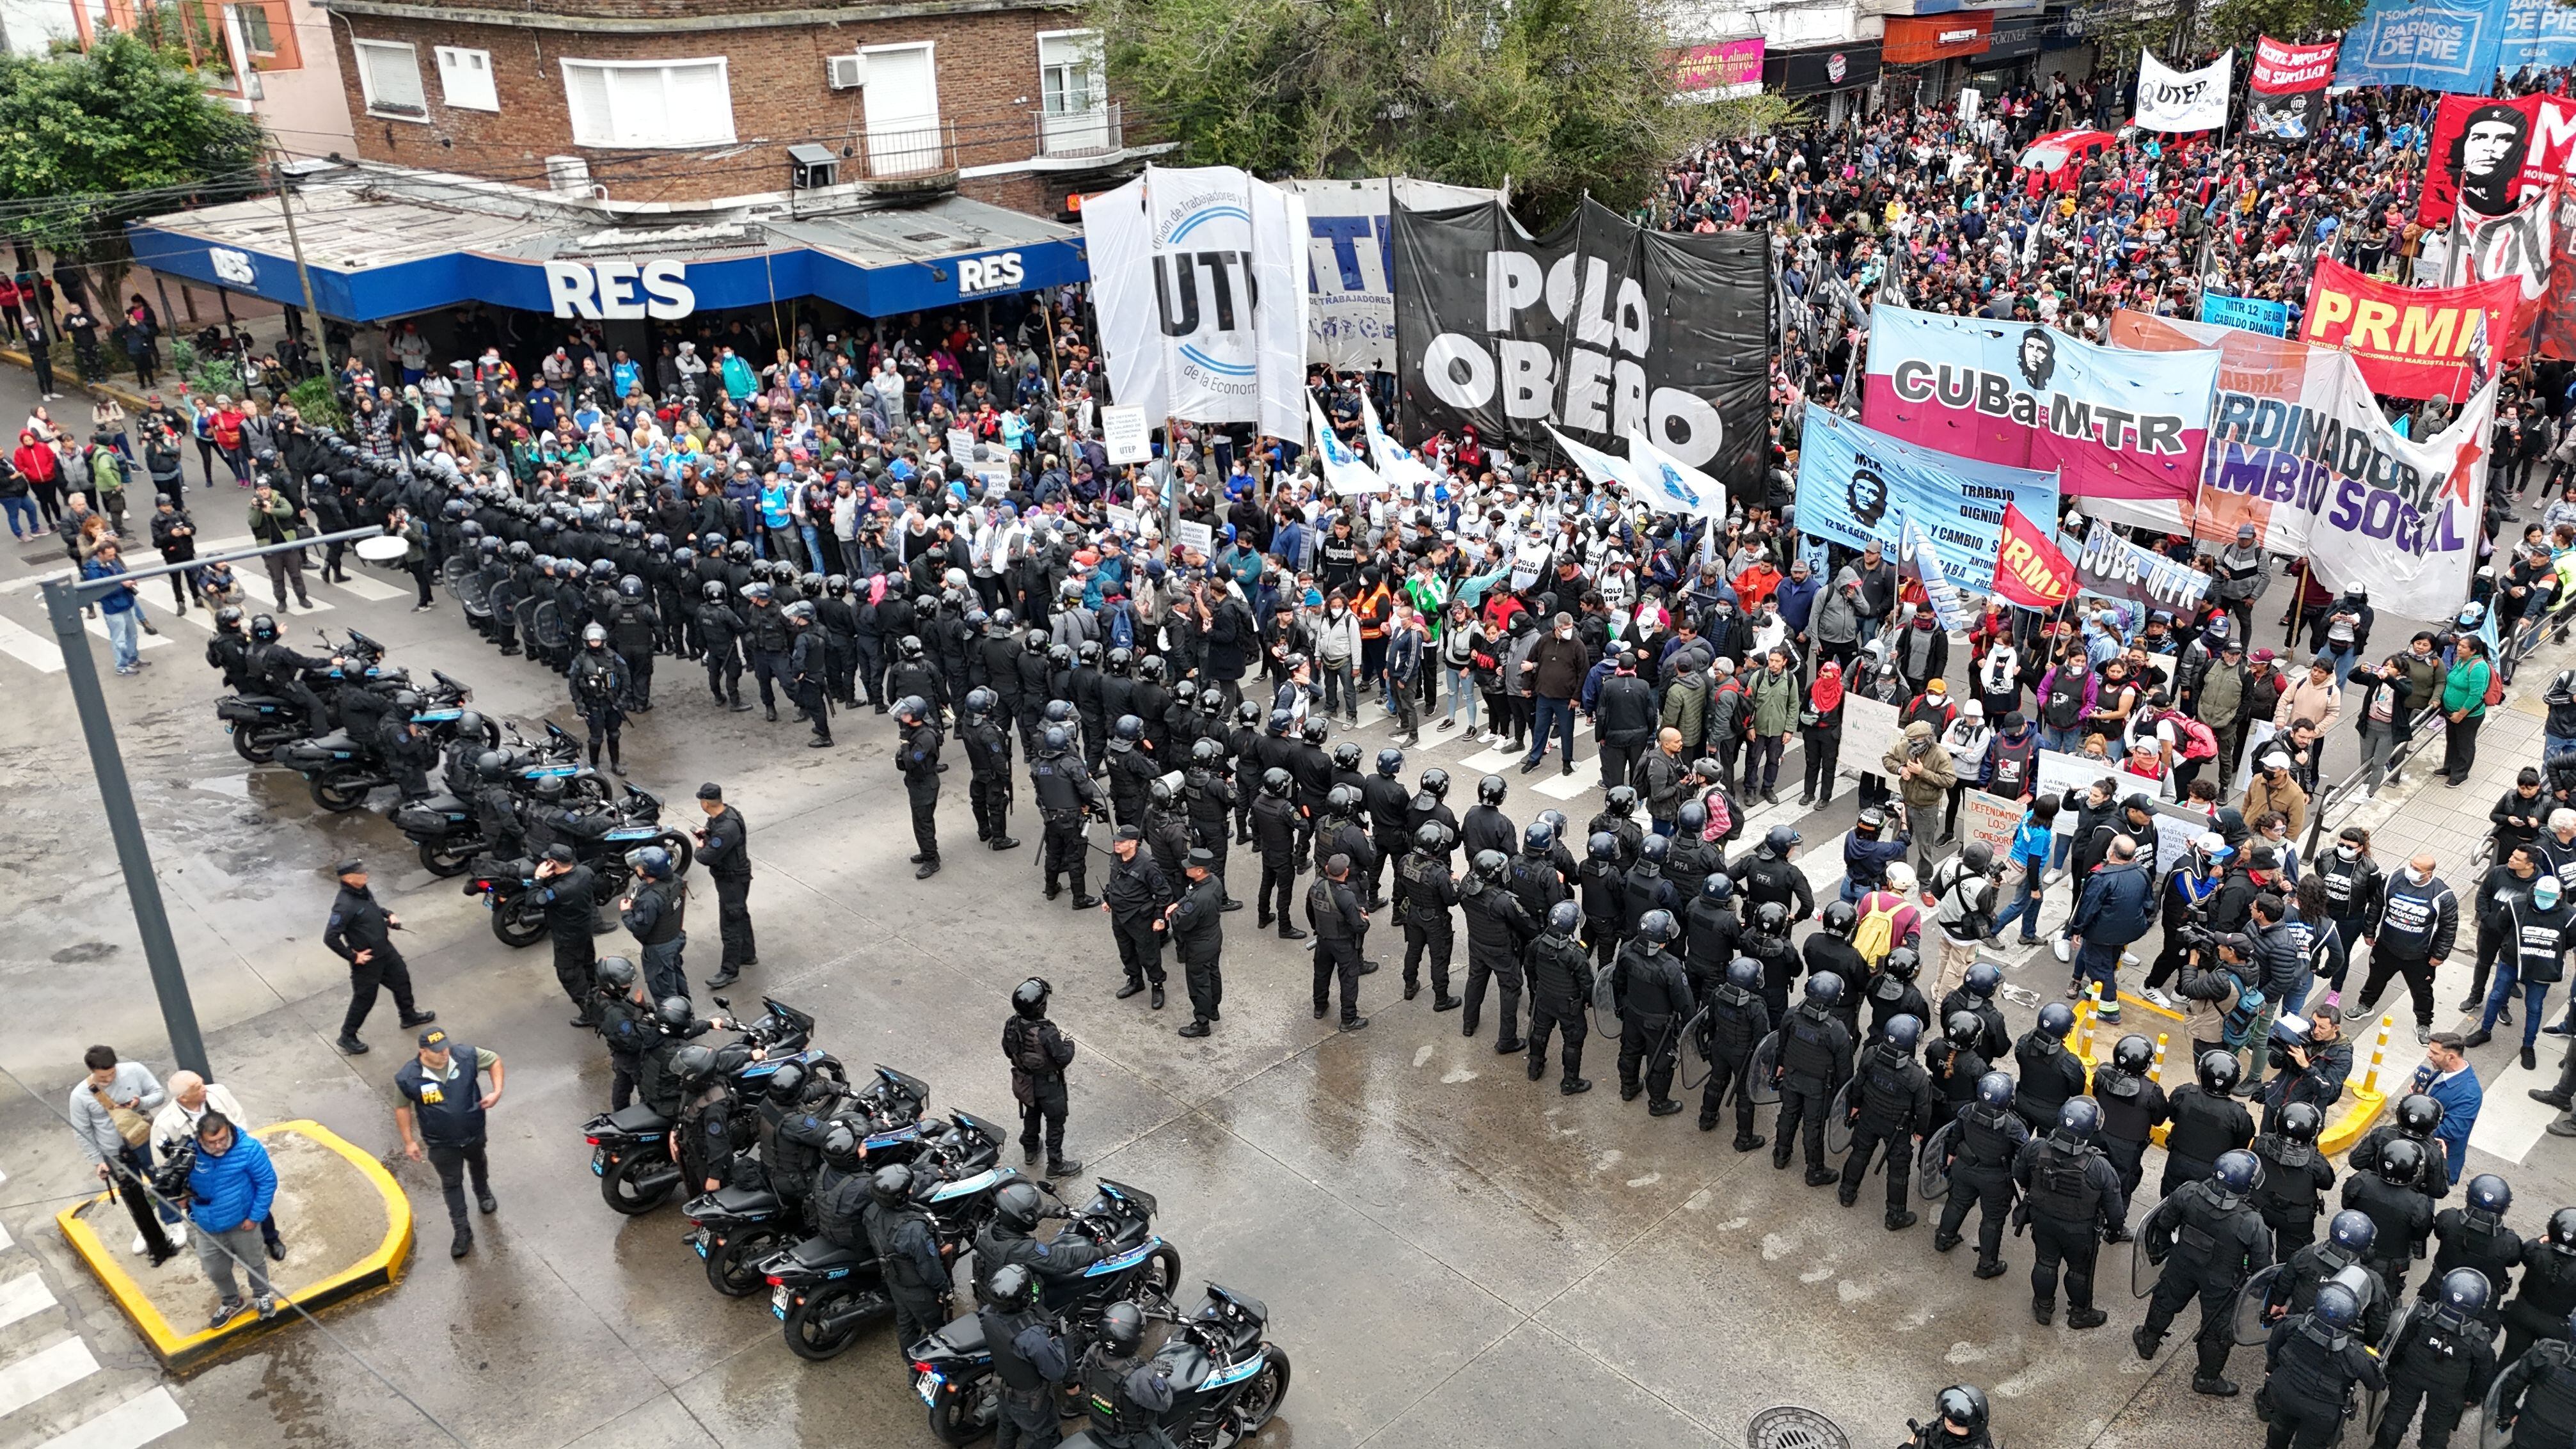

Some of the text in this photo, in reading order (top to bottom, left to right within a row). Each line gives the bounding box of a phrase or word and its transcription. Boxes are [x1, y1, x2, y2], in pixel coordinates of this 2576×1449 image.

[2383, 21, 2463, 41] BARRIOS
[2378, 35, 2461, 61] DE PIE
[2156, 79, 2207, 106] UTEP
[2290, 99, 2307, 109] UTEP
[1152, 190, 1242, 250] Unión de Trabajadores y
[957, 252, 1023, 292] RES
[544, 258, 695, 320] RES
[1319, 294, 1392, 306] TRABAJADORES
[2225, 299, 2245, 313] MTR
[2247, 303, 2259, 317] 12
[2214, 313, 2273, 336] CABILDO DIANA
[2307, 338, 2339, 352] PARTIDO
[2404, 356, 2445, 367] MARXISTA
[1183, 364, 1199, 380] de
[1199, 372, 1209, 387] la
[1893, 360, 2039, 427] CUBa
[2050, 391, 2187, 455] MTR
[1119, 445, 1136, 455] UTEP
[1961, 484, 2014, 502] TRABAJO
[1824, 518, 1834, 528] 12
[1836, 521, 1847, 534] DE
[1931, 523, 1984, 551] Y CAMBIO
[2080, 521, 2140, 585] CUBa
[1513, 565, 1539, 574] OBRERO
[1517, 560, 1536, 568] POLO
[1971, 801, 2021, 823] DEFENDAMOS
[1987, 818, 2006, 830] LOS
[1406, 868, 1418, 879] PFA
[1674, 860, 1689, 871] PFA
[1756, 872, 1771, 885] PFA
[2388, 907, 2426, 923] autónoma
[2524, 937, 2553, 946] autónoma
[427, 1031, 445, 1045] PFA
[421, 1090, 445, 1105] PFA
[695, 1242, 707, 1258] PFA
[827, 1269, 849, 1281] 3760
[772, 1306, 785, 1320] PFA
[919, 1393, 935, 1408] PFA
